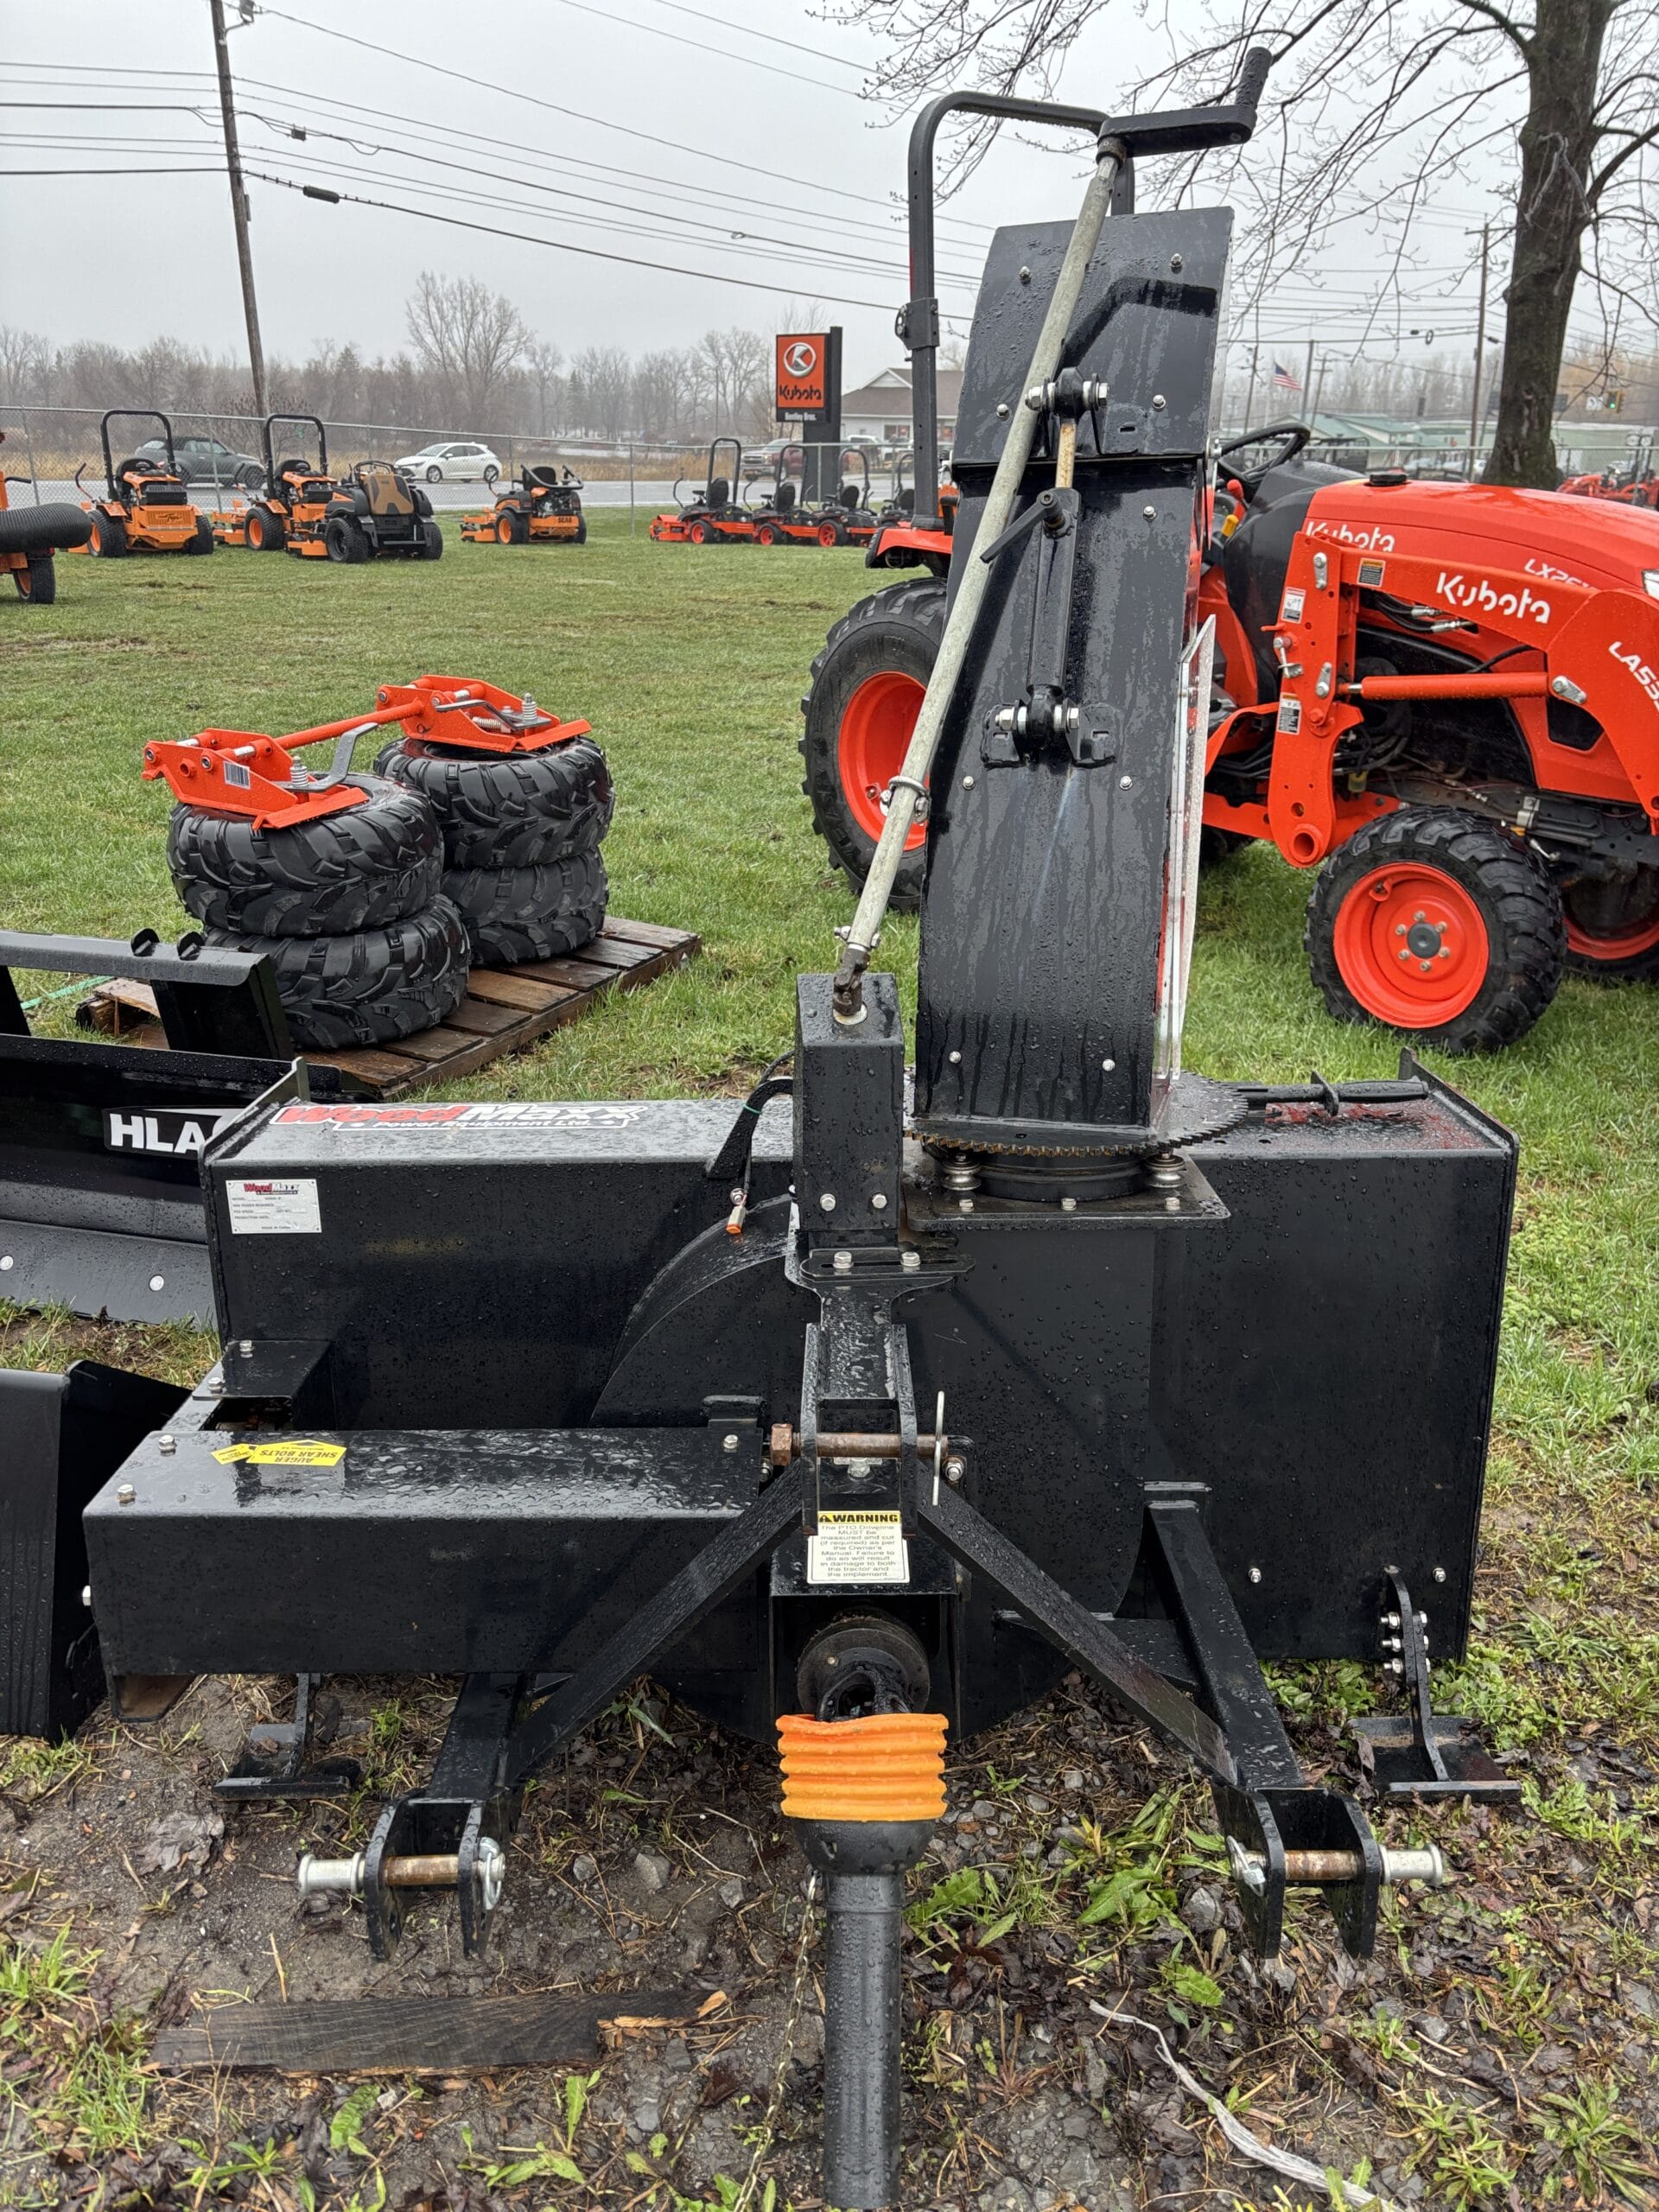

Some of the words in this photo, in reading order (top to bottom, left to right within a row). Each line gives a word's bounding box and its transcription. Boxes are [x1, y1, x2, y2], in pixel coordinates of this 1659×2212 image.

[779, 385, 822, 400] Kubota
[1436, 572, 1551, 624] Kubota
[1608, 641, 1659, 712] LA53
[442, 1120, 551, 1128] Equipment
[832, 1514, 898, 1522] WARNING
